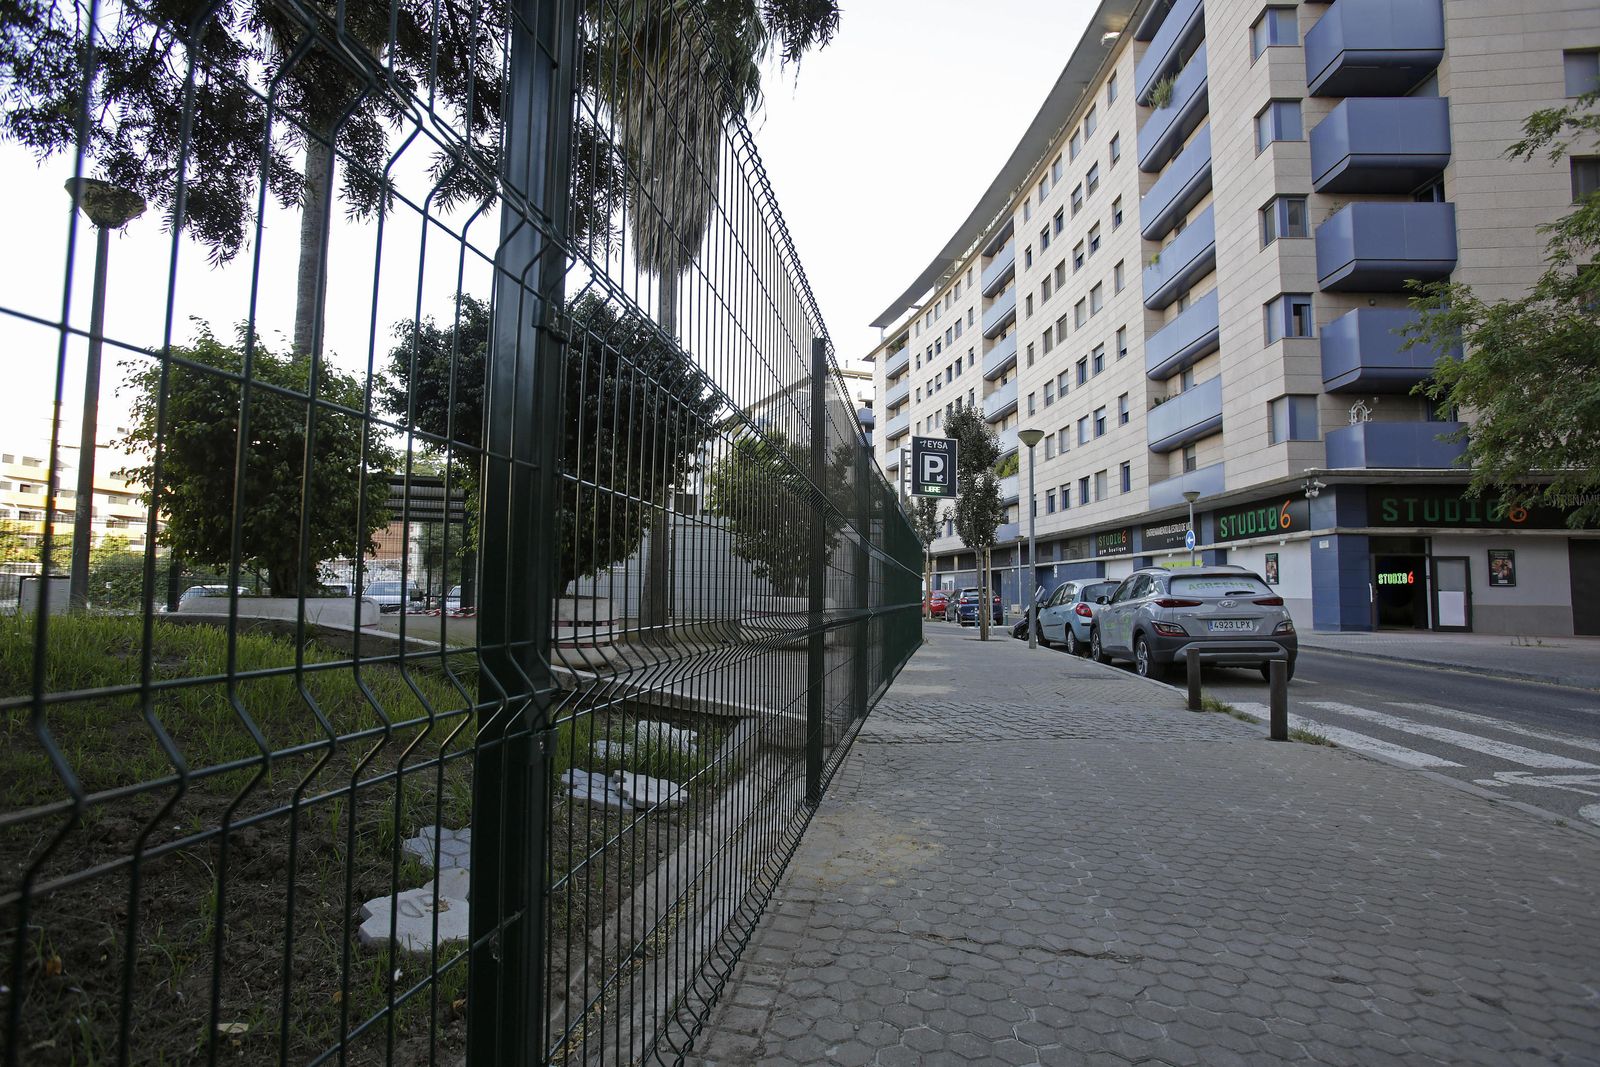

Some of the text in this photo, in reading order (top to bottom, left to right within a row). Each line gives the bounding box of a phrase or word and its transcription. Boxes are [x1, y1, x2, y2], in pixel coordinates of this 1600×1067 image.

[927, 440, 948, 449] EYSA
[924, 455, 944, 481] P
[1214, 621, 1250, 629] 4923 LPX
